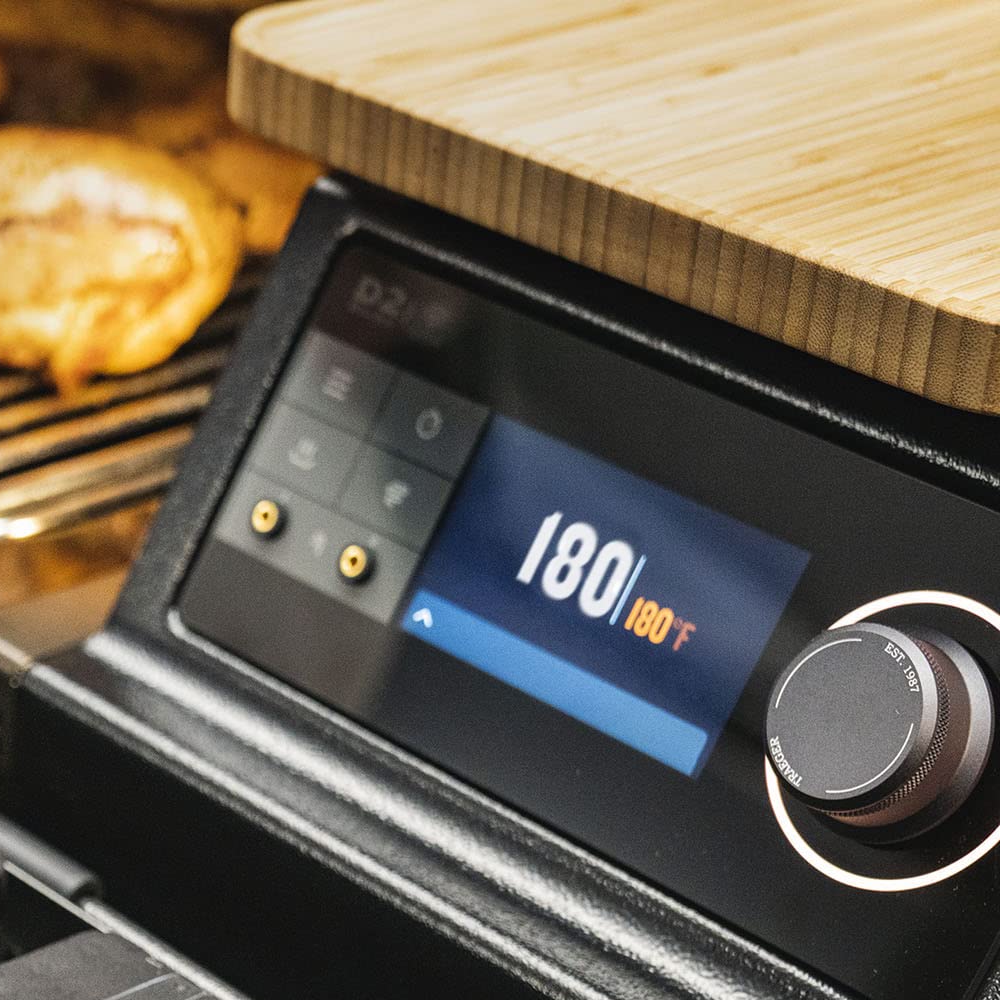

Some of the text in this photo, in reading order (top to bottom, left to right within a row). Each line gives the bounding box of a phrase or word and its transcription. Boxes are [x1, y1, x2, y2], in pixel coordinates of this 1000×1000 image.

[516, 511, 635, 618] 180
[884, 642, 920, 693] EST. 1987
[770, 736, 803, 788] TRAEGER
